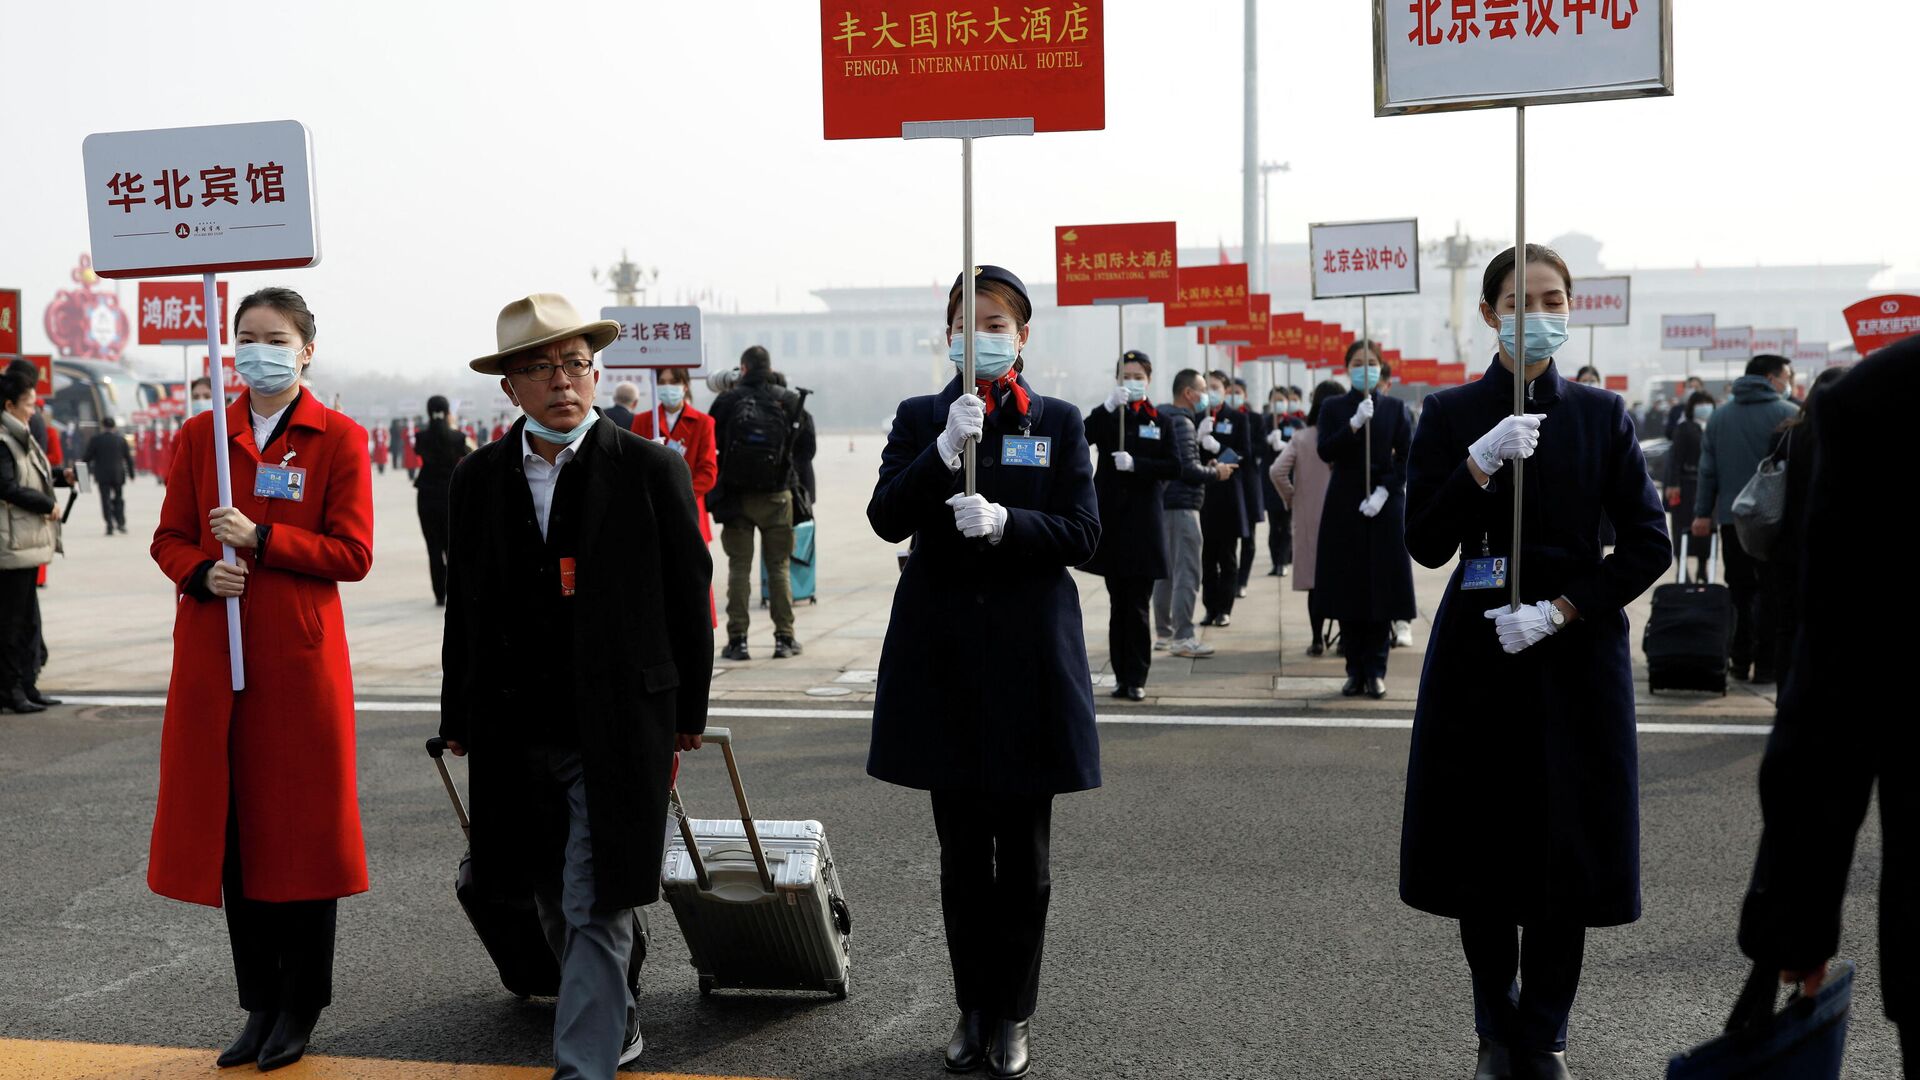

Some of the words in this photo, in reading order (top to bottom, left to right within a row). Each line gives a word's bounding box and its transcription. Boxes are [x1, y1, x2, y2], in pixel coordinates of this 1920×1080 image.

[832, 2, 1089, 54] 丰大国际大酒店
[844, 59, 899, 77] FENGDA
[910, 55, 1027, 74] INTERNATIONAL
[1037, 51, 1083, 69] HOTEL
[106, 161, 286, 213] 华北宾馆
[1061, 249, 1173, 272] 丰大国际大酒店
[1323, 245, 1408, 273] 北京会议中心
